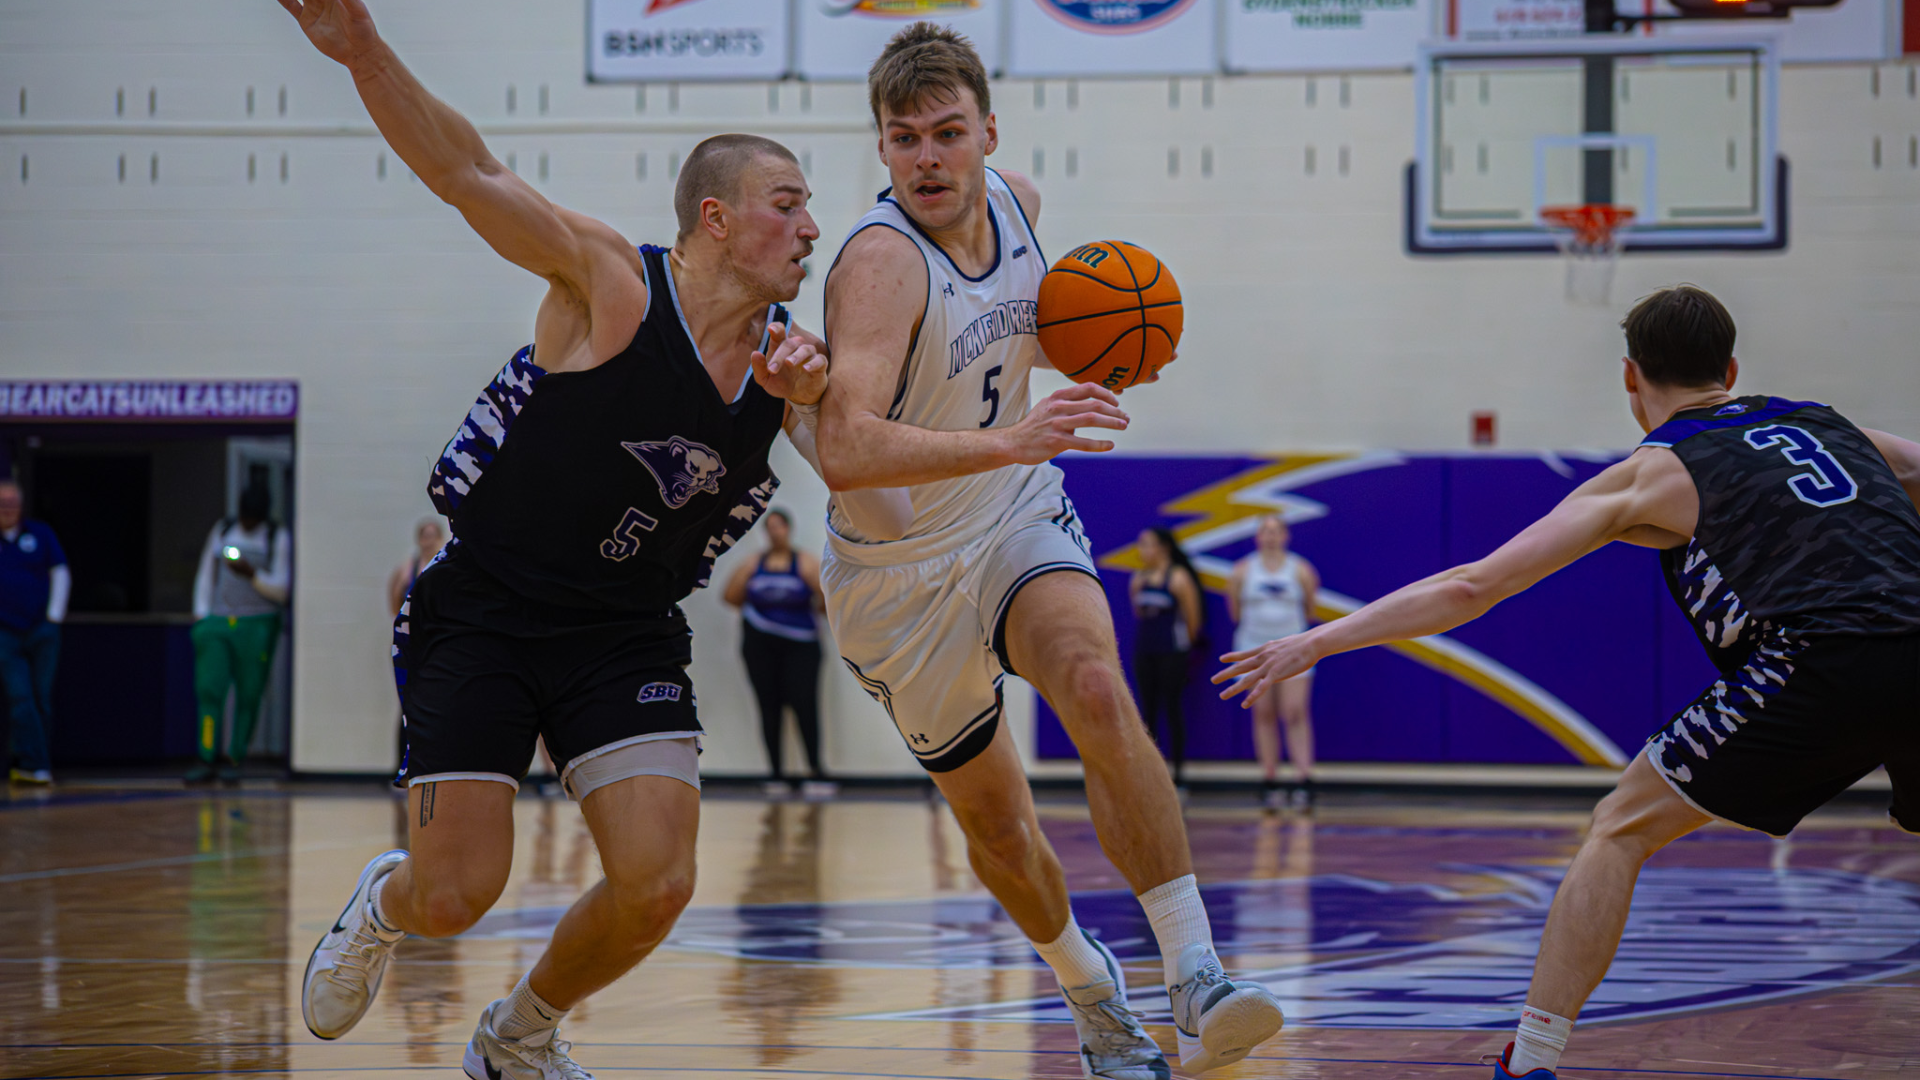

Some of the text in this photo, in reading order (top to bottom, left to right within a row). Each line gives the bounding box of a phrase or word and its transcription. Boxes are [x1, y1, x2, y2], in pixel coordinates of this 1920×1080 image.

[979, 364, 1003, 429] 5
[1743, 424, 1858, 508] 3
[600, 506, 658, 562] 5
[638, 683, 682, 702] SBU
